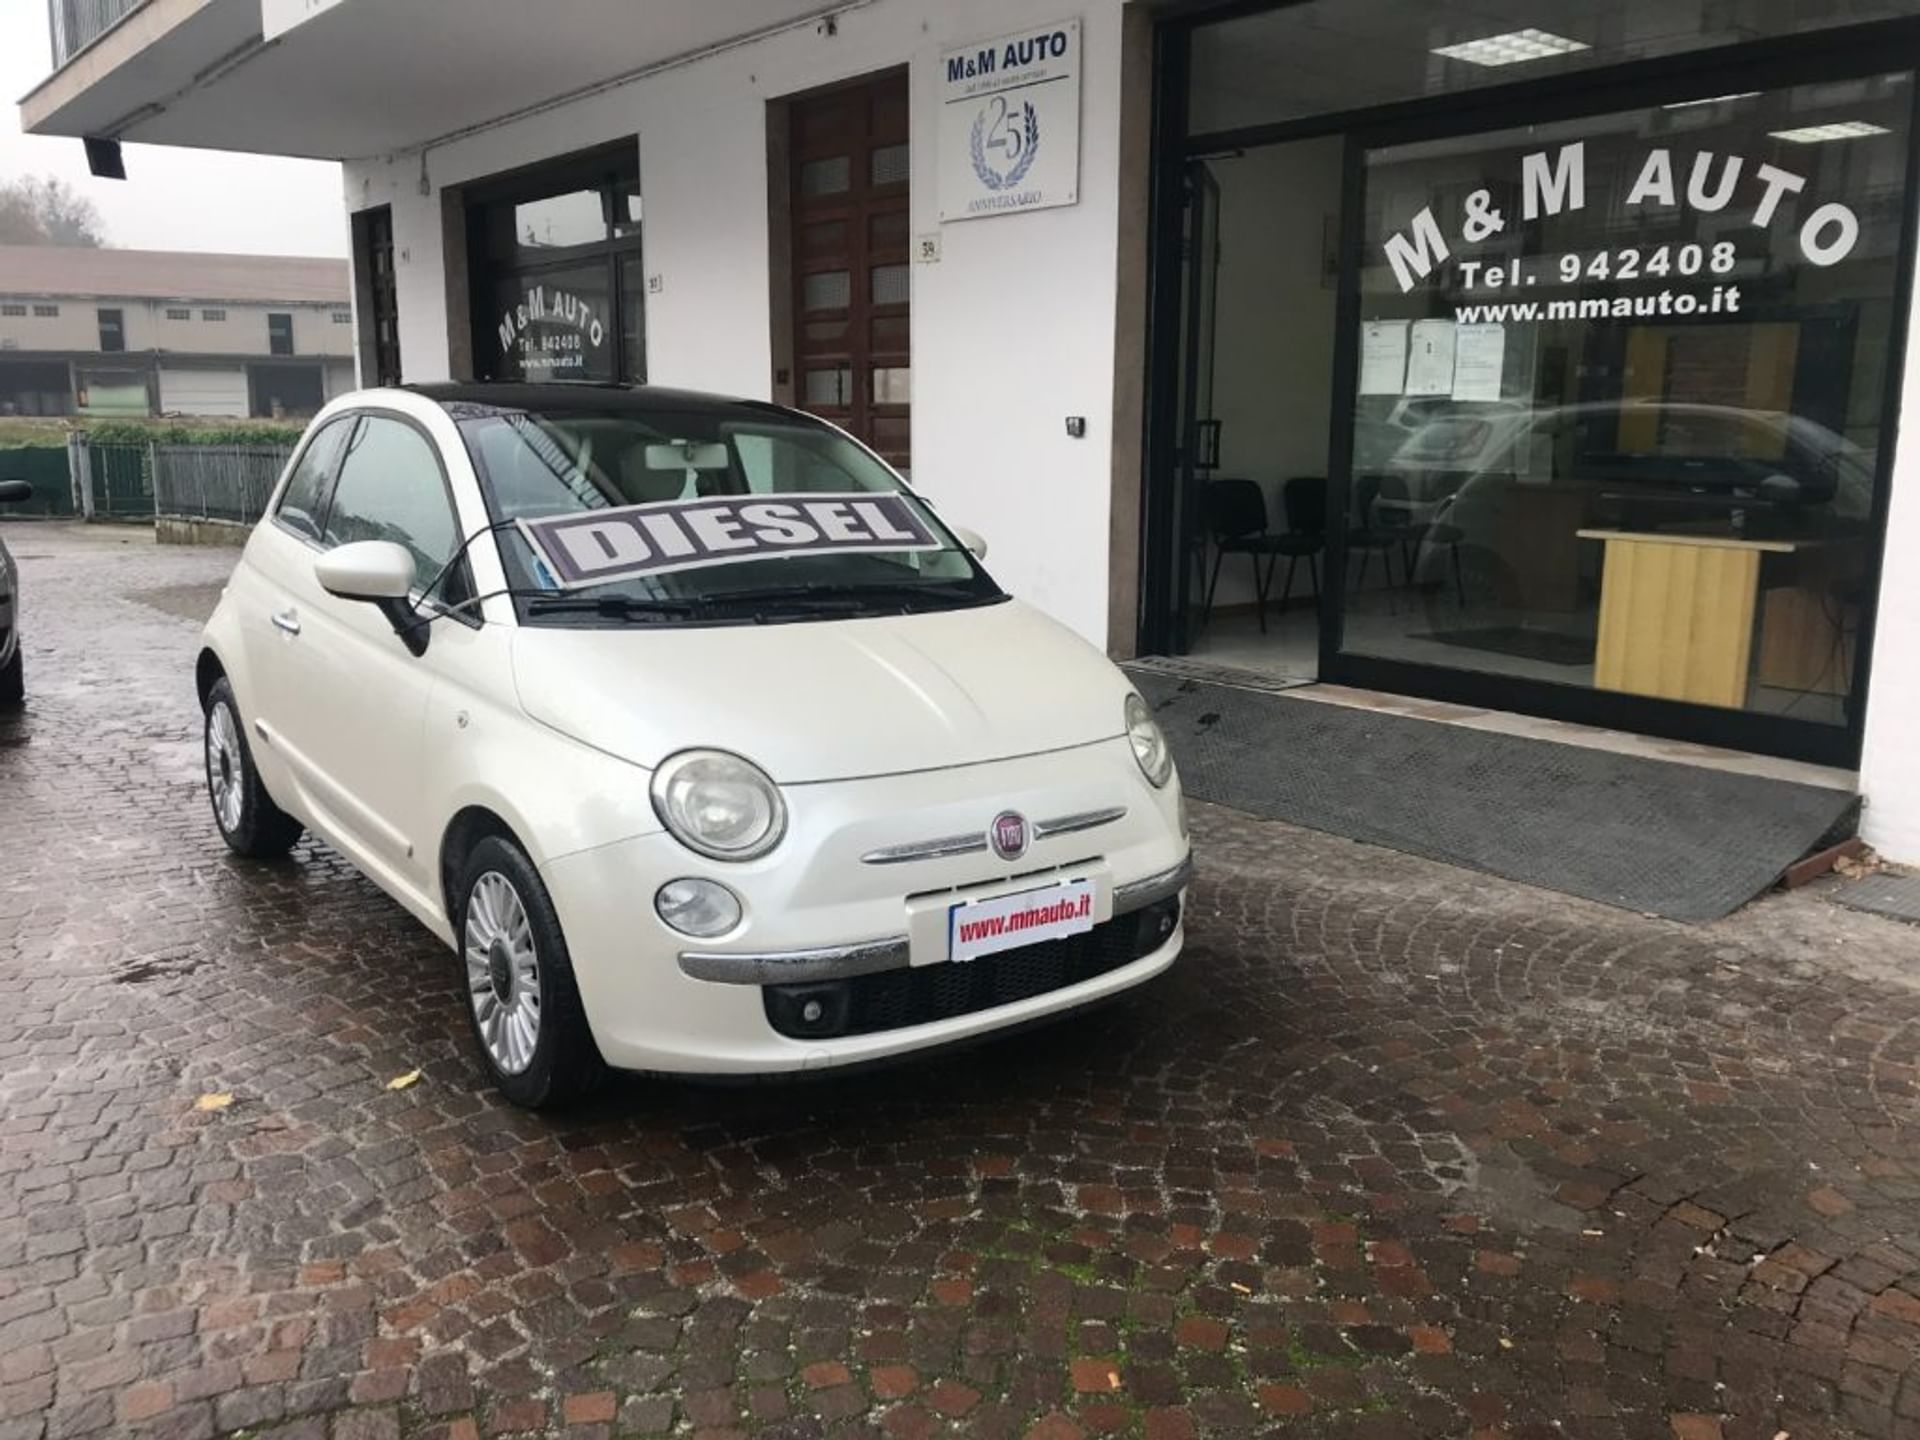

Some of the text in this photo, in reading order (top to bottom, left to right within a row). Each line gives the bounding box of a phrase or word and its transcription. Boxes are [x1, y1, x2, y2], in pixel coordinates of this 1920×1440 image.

[947, 47, 996, 83] M&M
[1002, 30, 1068, 69] AUTO
[986, 96, 1022, 160] 25
[1625, 149, 1859, 266] AUTO
[1459, 241, 1737, 290] Tel. 942408
[552, 290, 603, 347] AUTO
[1454, 285, 1742, 325] www.mmauto.it
[554, 501, 917, 572] DIESEL
[959, 893, 1092, 943] www.mmauto.it
